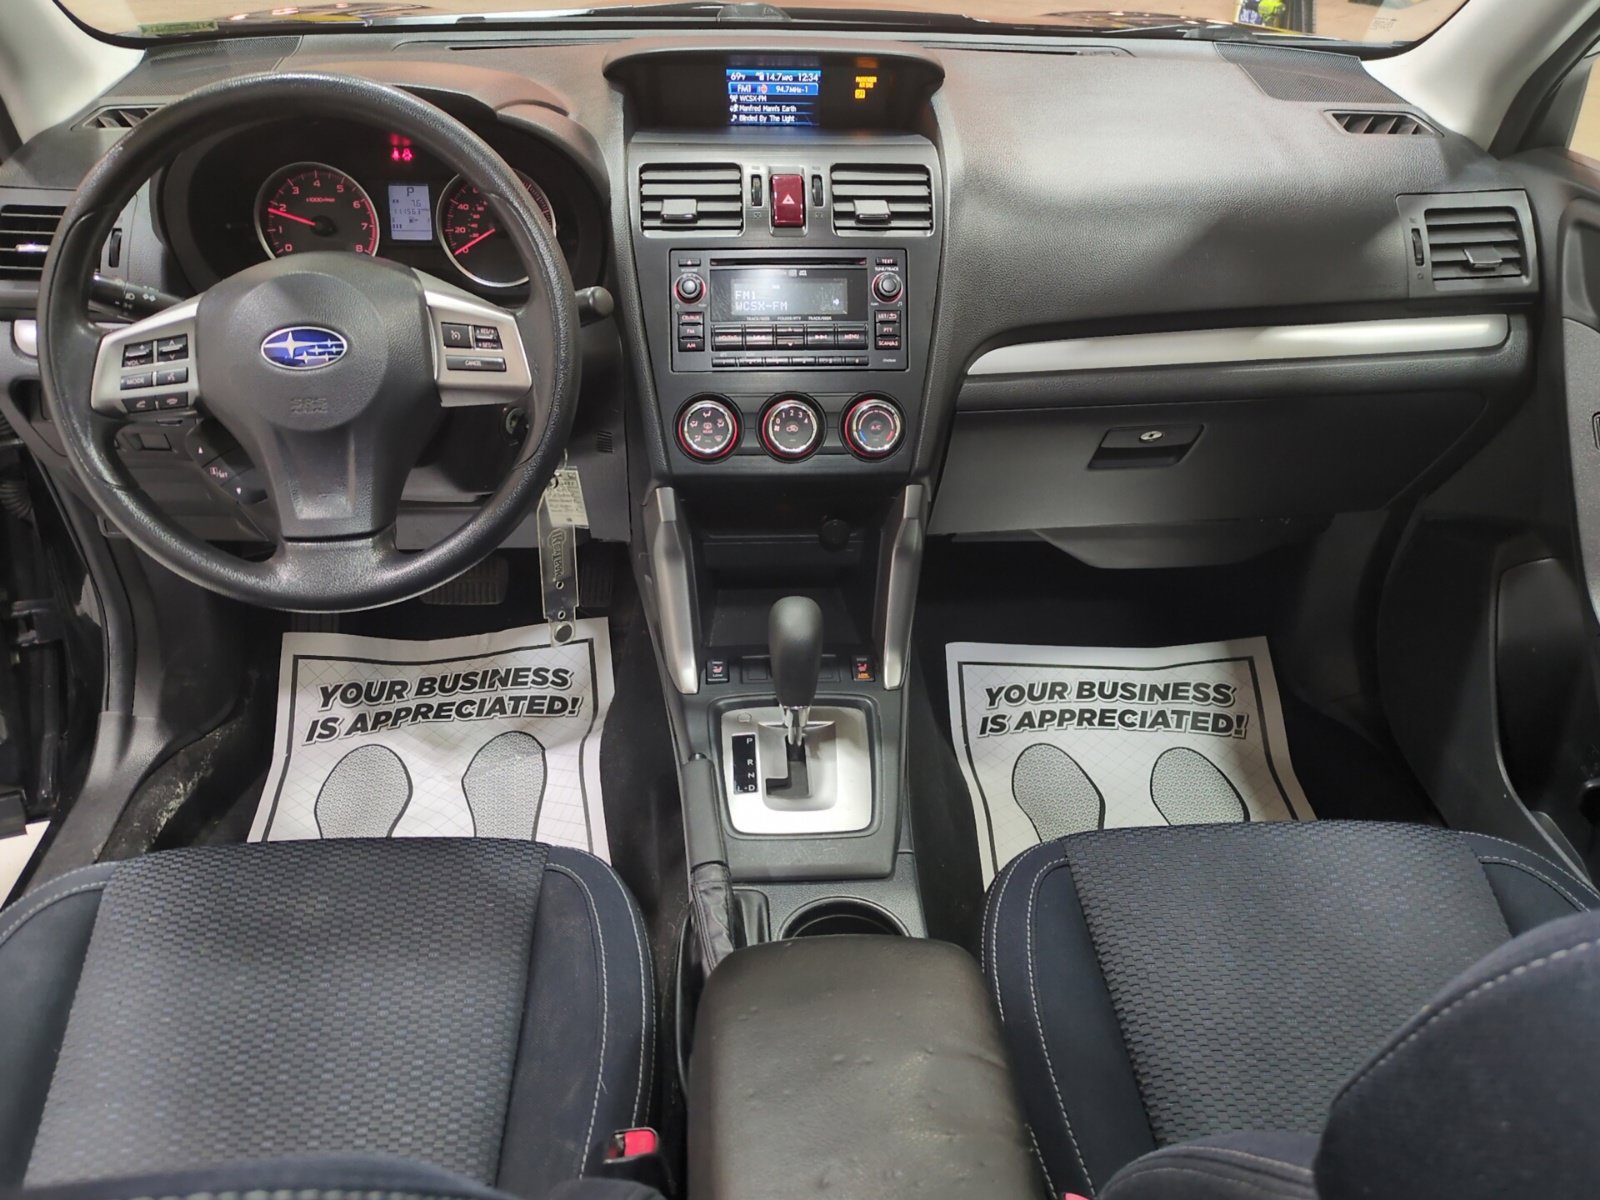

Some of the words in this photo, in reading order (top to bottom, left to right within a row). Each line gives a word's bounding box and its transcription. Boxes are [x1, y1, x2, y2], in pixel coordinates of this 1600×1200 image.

[799, 73, 818, 81] 12:34
[770, 114, 780, 122] The
[782, 114, 795, 124] Light
[313, 179, 321, 188] 4
[292, 186, 300, 195] 3
[336, 184, 345, 193] 5
[406, 186, 415, 197] P
[279, 203, 288, 212] 2
[352, 200, 361, 209] 6
[457, 203, 470, 211] 40
[360, 222, 369, 231] 7
[454, 226, 467, 234] 20
[284, 243, 294, 253] 0
[355, 244, 365, 253] 8
[734, 290, 756, 300] FM1
[734, 301, 788, 311] WCSX-FM
[319, 679, 411, 710] YOUR
[413, 667, 573, 698] BUSINESS
[984, 681, 1072, 707] YOUR
[1075, 680, 1237, 706] BUSINESS
[303, 716, 342, 744] IS
[343, 695, 584, 737] APPRECIATED!
[978, 715, 1011, 737] IS
[1014, 707, 1250, 739] APPRECIATED!
[746, 737, 753, 745] P
[746, 758, 754, 766] R
